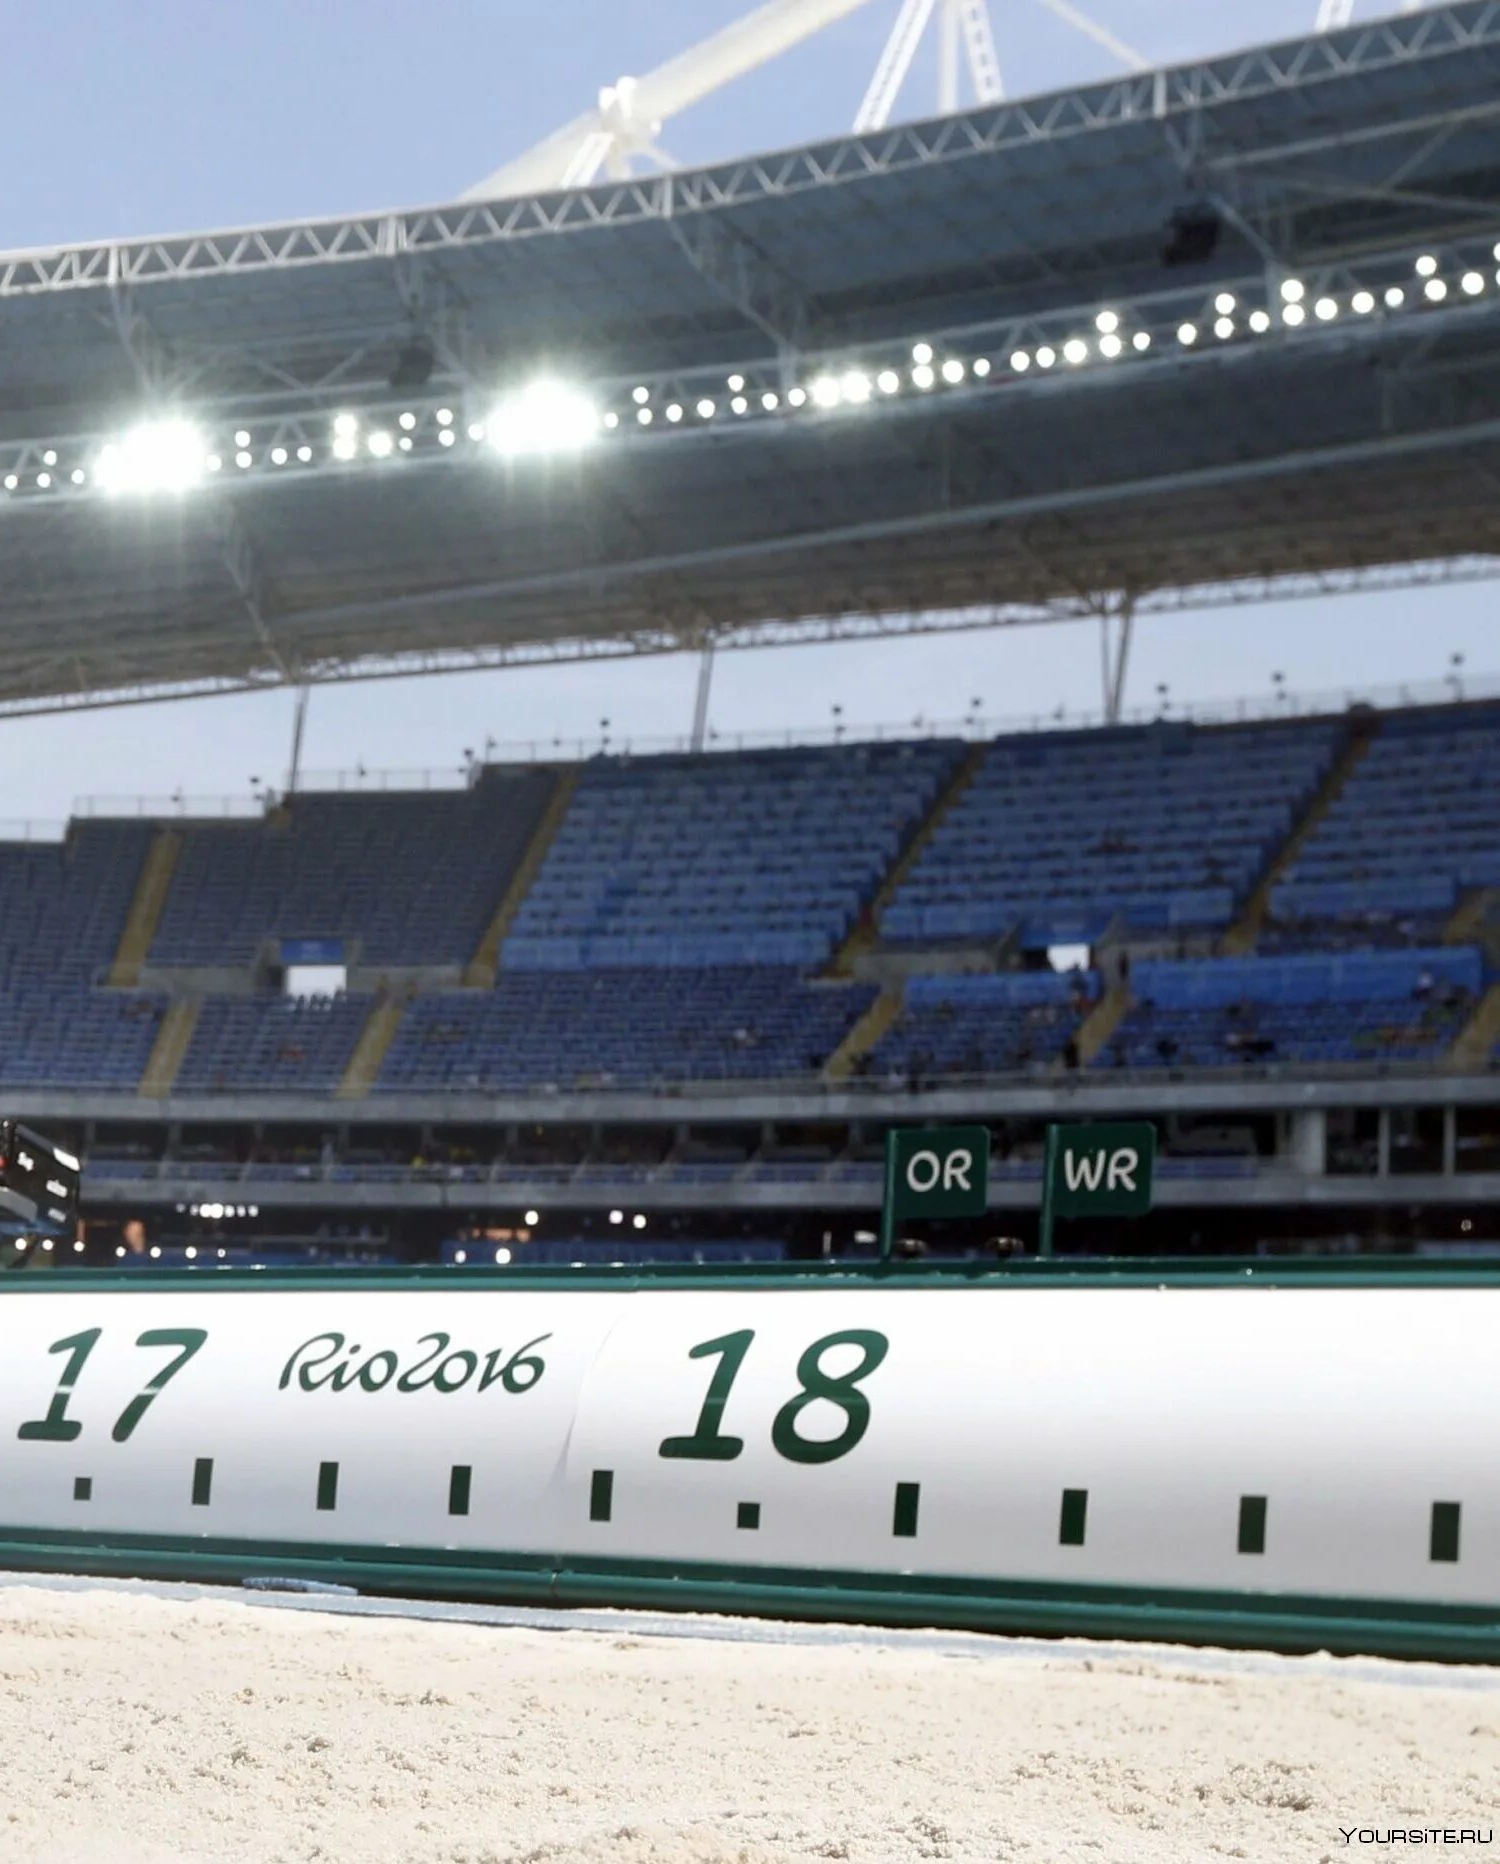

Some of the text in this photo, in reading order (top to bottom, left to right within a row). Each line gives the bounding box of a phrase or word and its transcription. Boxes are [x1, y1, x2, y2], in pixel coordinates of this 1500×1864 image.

[907, 1149, 972, 1192] OR
[1064, 1148, 1138, 1191] WR
[16, 1327, 209, 1443] 17
[278, 1331, 554, 1395] Rio2016
[657, 1329, 889, 1466] 18
